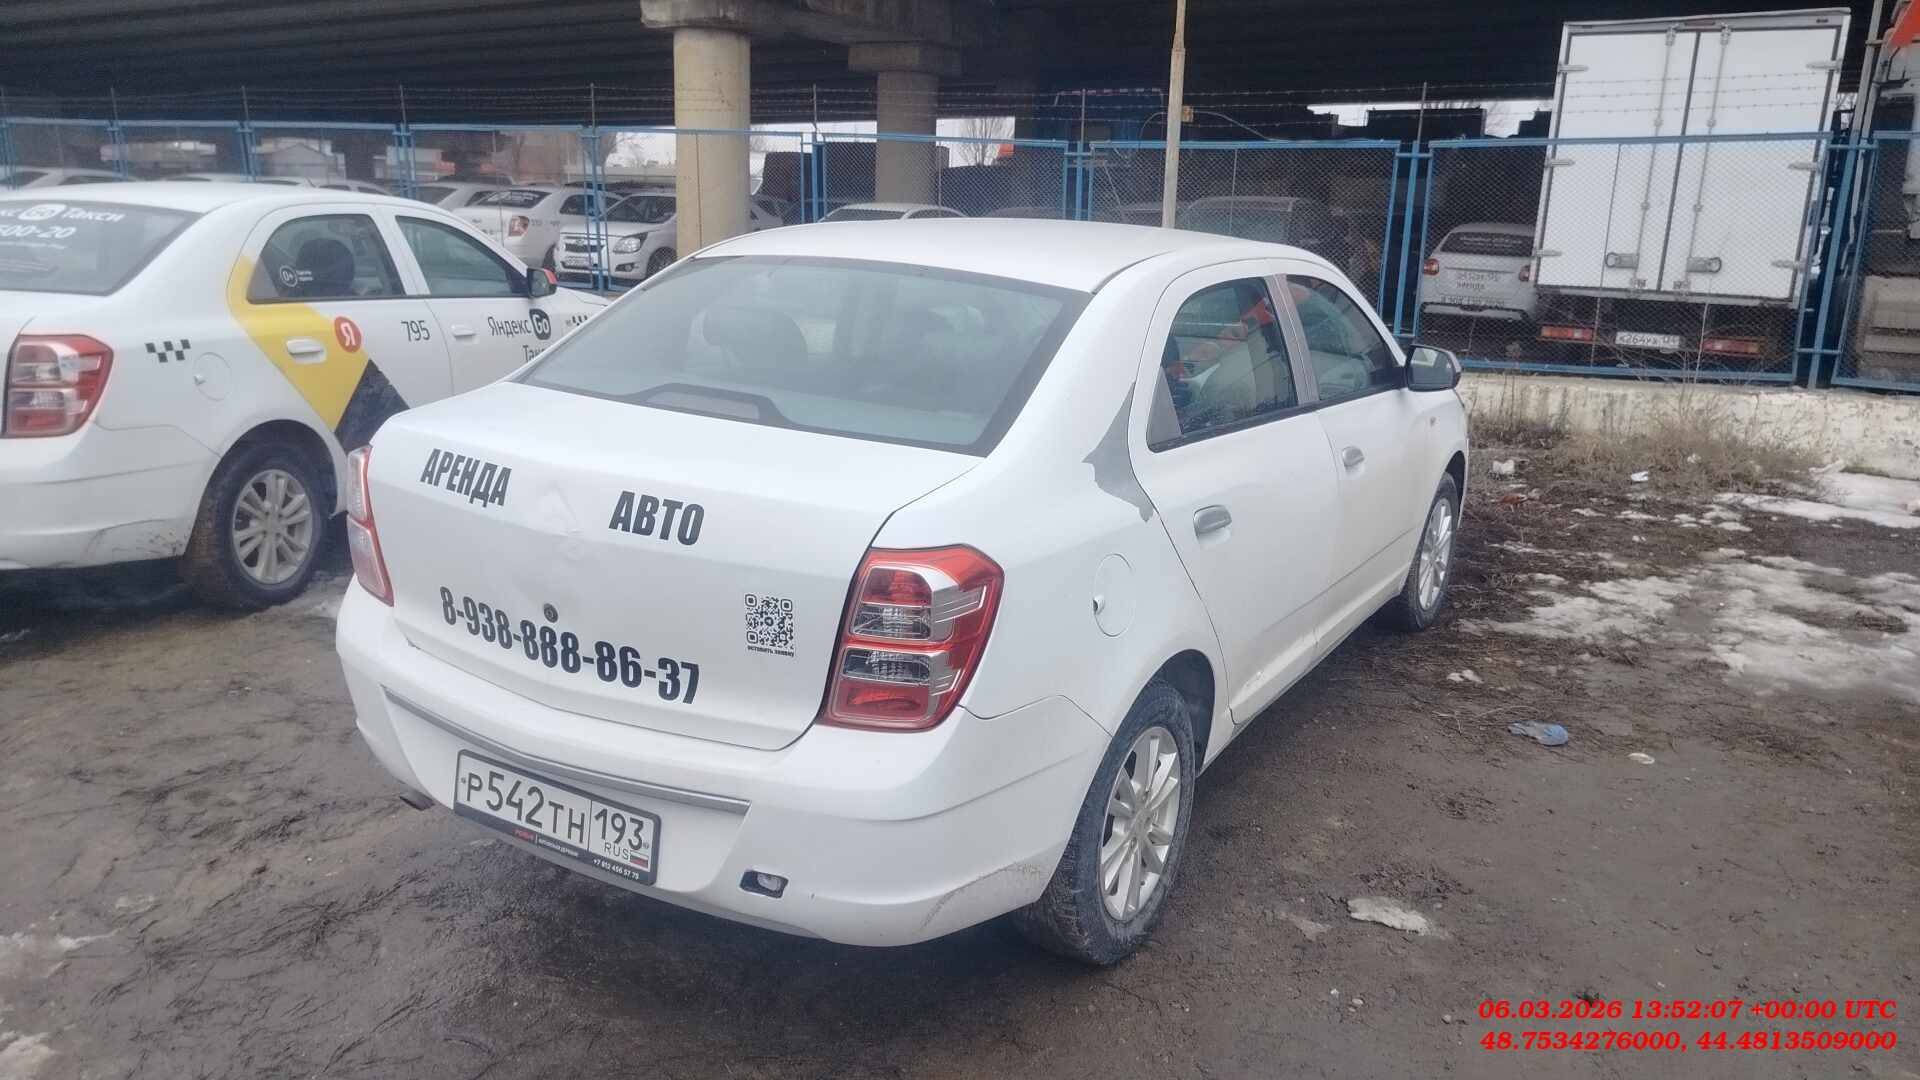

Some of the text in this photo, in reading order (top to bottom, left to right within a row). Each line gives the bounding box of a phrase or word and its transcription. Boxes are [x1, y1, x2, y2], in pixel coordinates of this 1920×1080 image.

[339, 320, 356, 347] Я
[401, 320, 430, 342] 795
[487, 310, 551, 338] Яндекс Go
[419, 448, 705, 546] АРЕНДА АВТО
[439, 586, 700, 705] 8-938-888-86-37
[466, 771, 644, 850] Р542ТН 193
[604, 840, 630, 860] RUS
